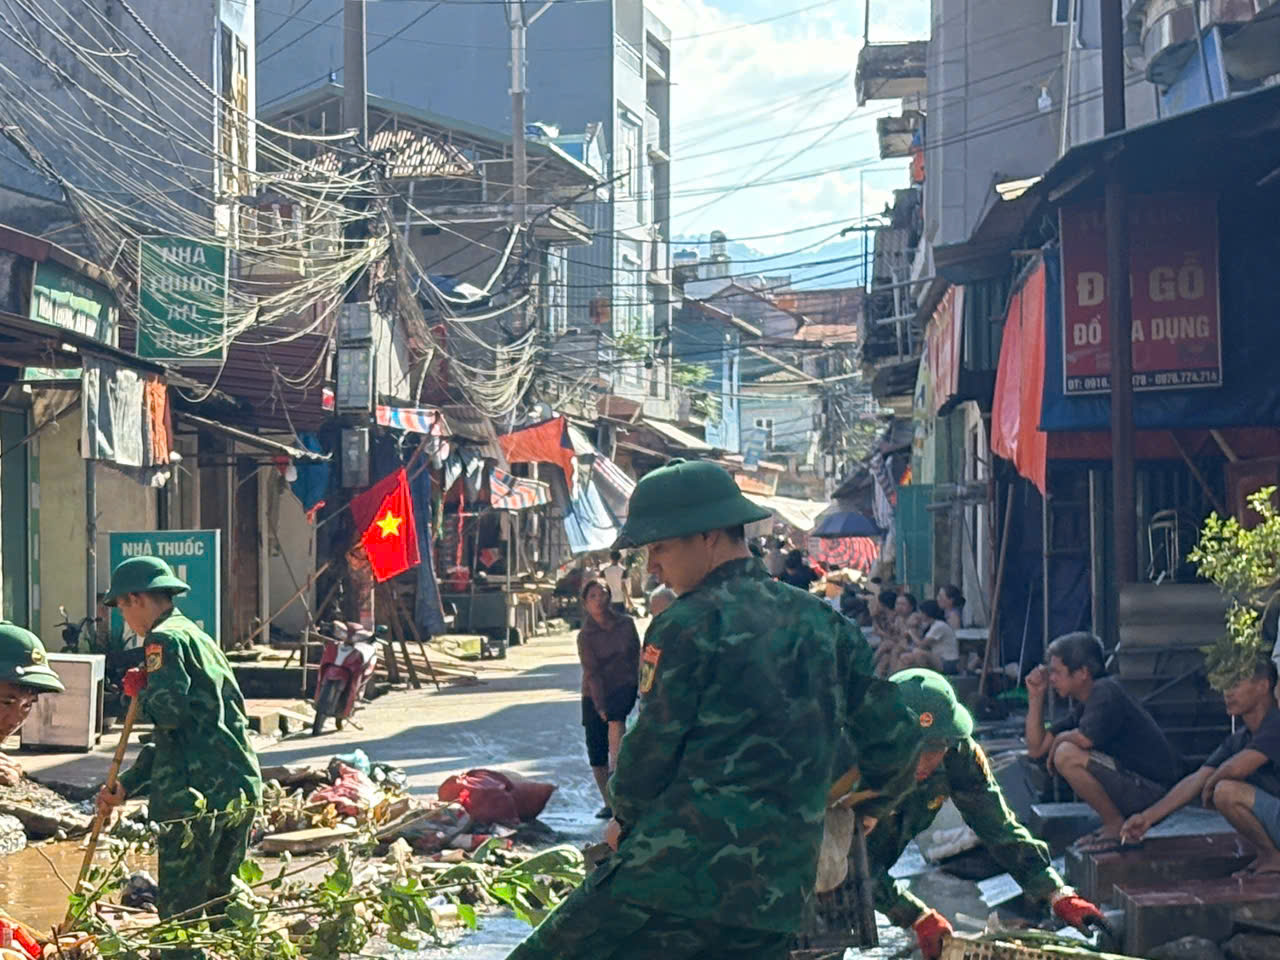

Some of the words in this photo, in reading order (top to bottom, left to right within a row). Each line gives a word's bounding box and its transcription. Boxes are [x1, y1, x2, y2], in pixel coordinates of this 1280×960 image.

[1151, 315, 1210, 345] DỤNG
[122, 539, 153, 557] NHÀ
[157, 536, 205, 557] THUỐC
